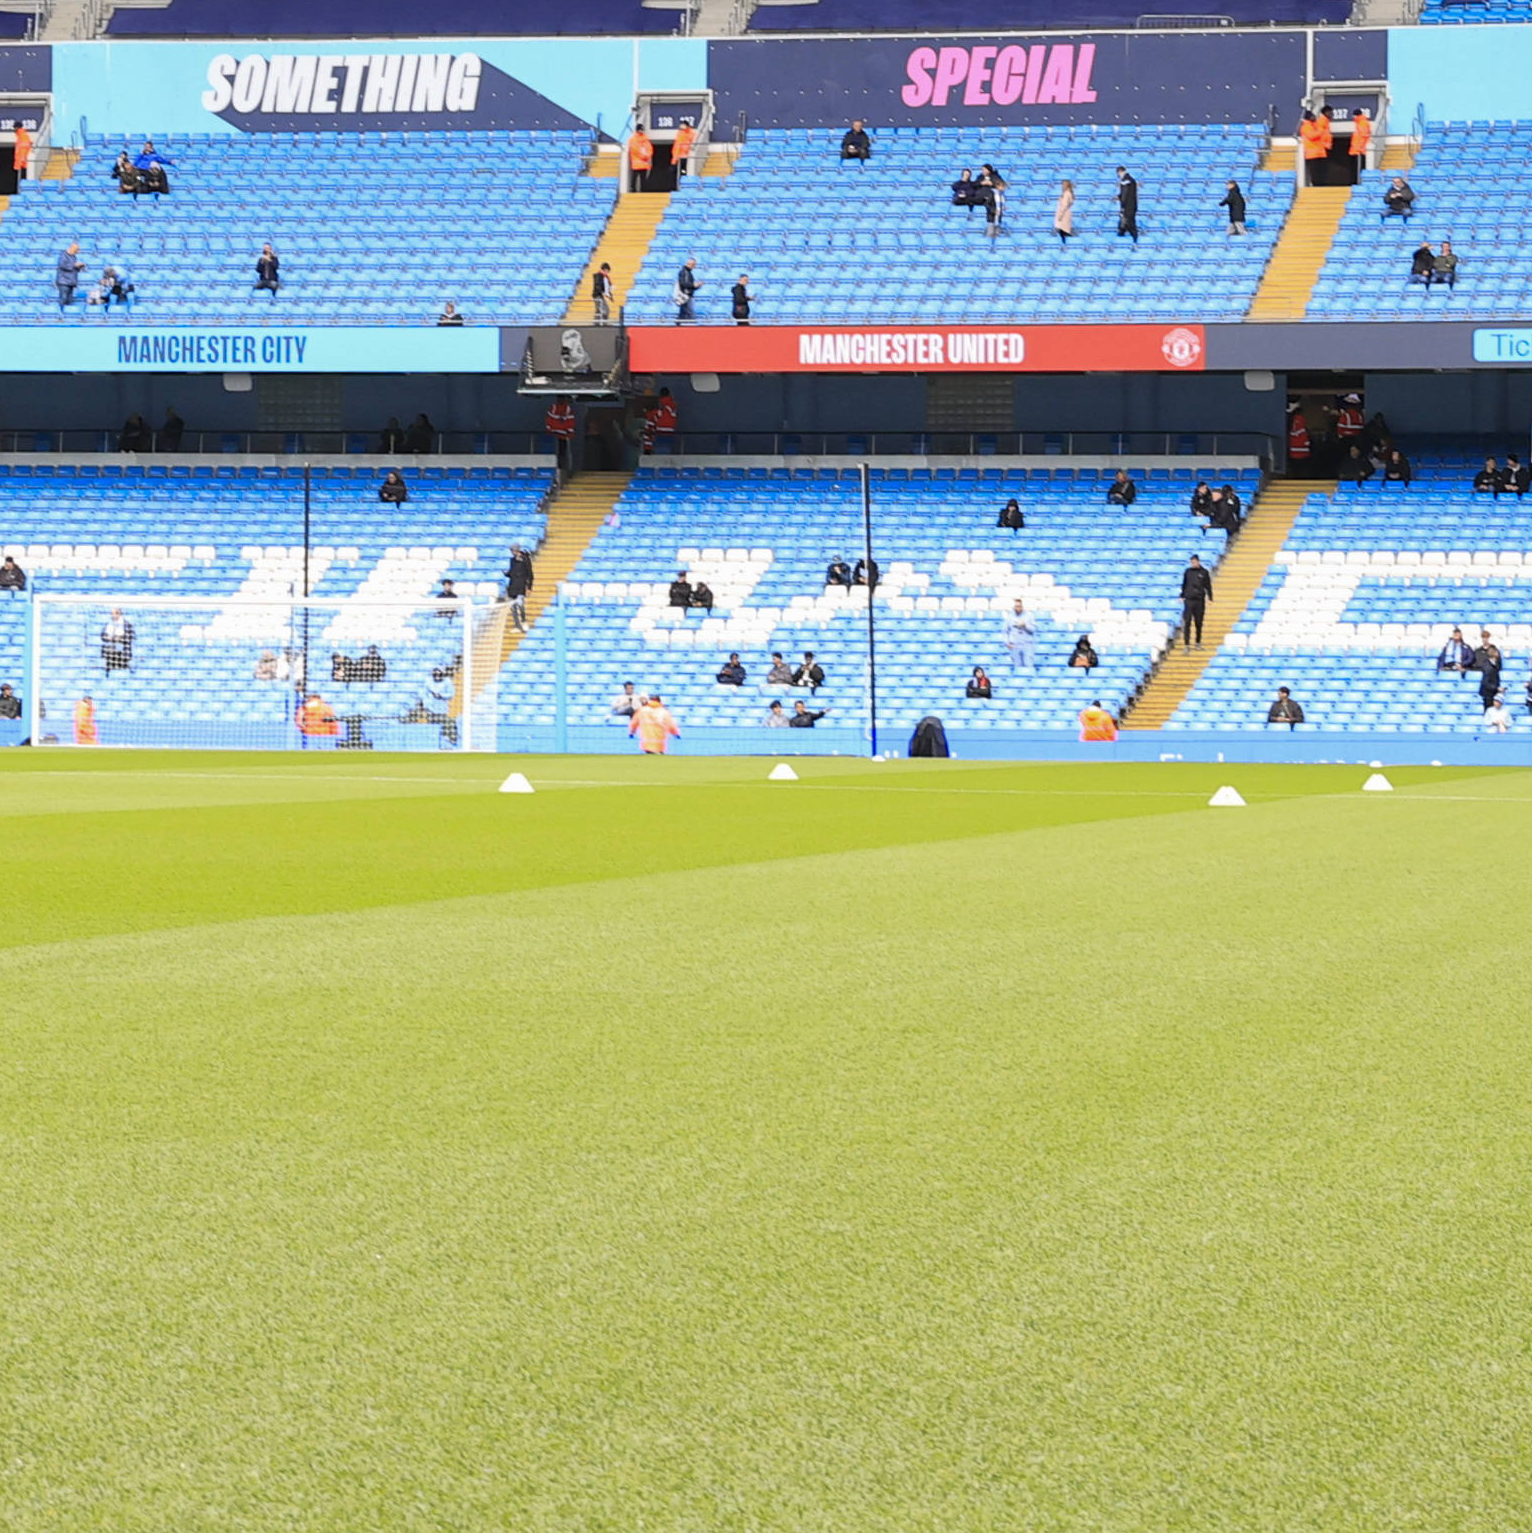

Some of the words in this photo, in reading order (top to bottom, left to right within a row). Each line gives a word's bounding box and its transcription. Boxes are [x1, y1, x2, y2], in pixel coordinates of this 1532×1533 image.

[201, 53, 482, 114] SOMETHING
[901, 43, 1097, 108] SPECIAL
[117, 335, 255, 364] MANCHESTER
[261, 335, 307, 363] CITY
[798, 332, 945, 365] MANCHESTER
[948, 332, 1025, 364] UNITED
